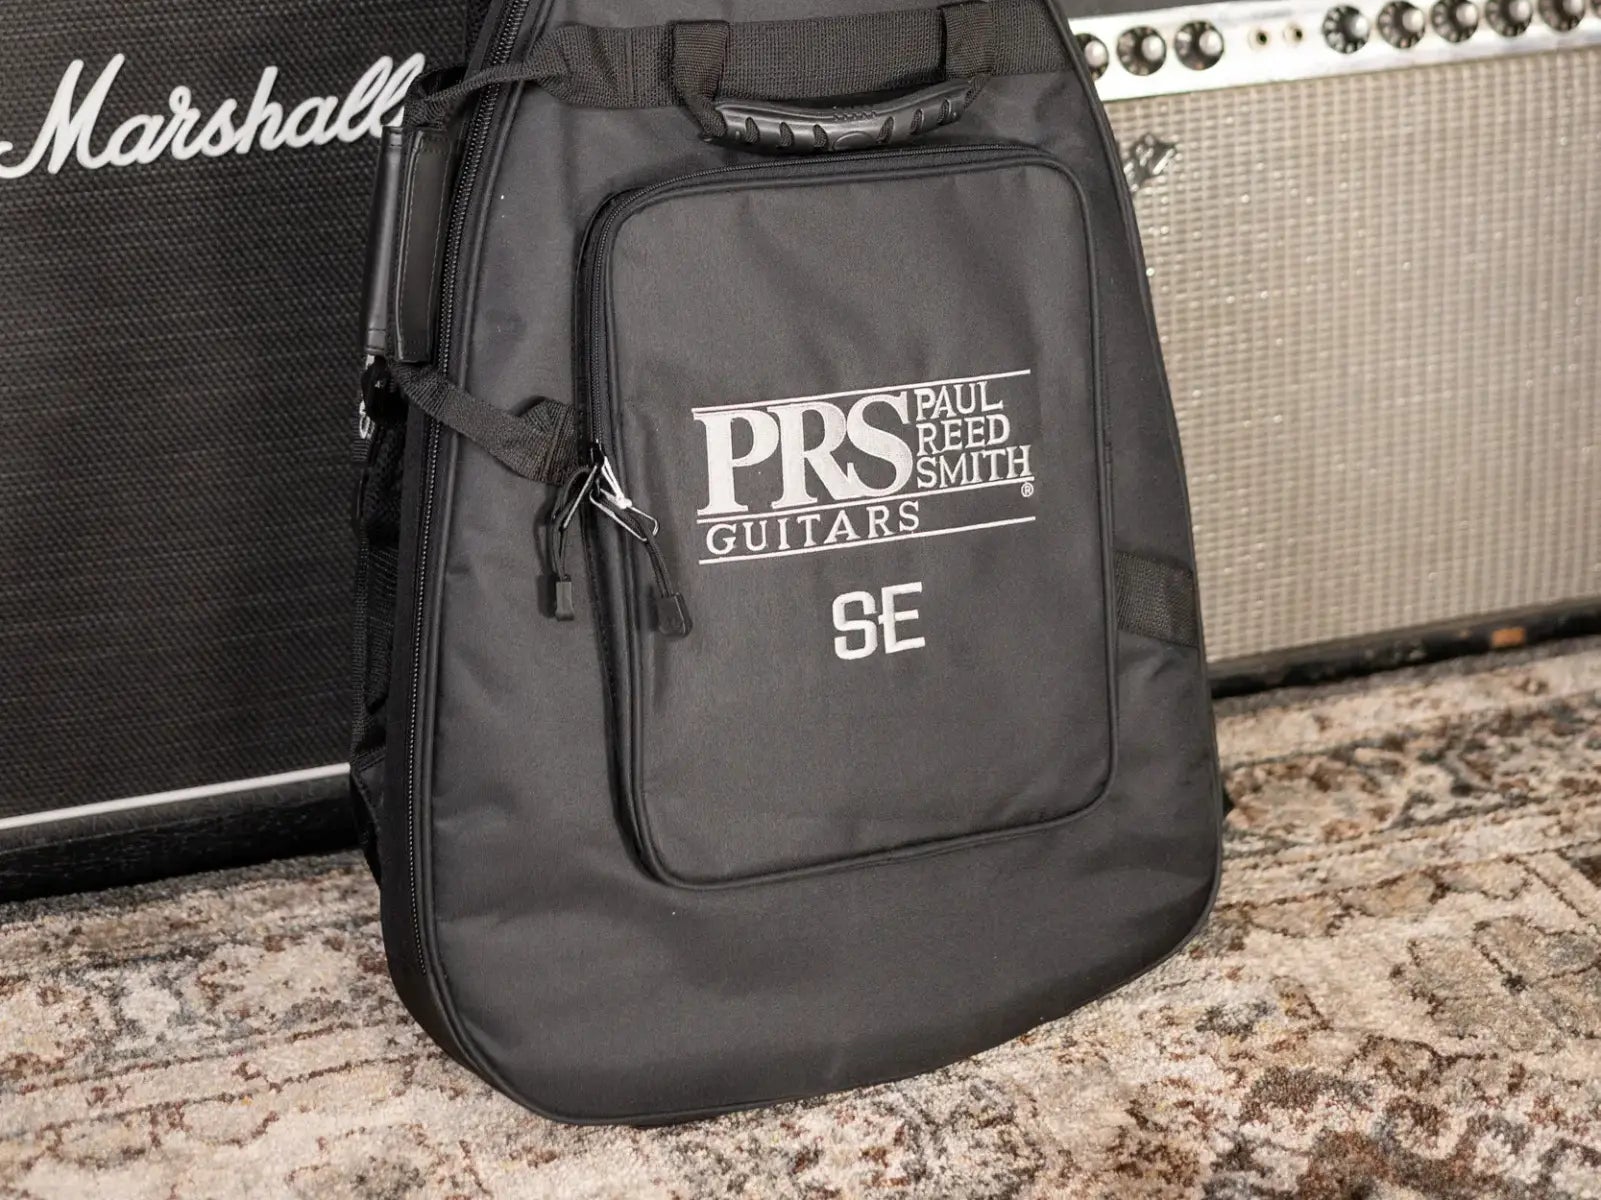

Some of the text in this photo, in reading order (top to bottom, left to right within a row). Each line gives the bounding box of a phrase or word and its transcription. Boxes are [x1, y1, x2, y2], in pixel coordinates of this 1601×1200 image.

[0, 53, 426, 179] Marshall
[915, 380, 1004, 421] PAUL
[693, 391, 913, 516] PRS
[915, 413, 1011, 457] REED
[916, 445, 1034, 489] SMITH
[705, 500, 920, 555] GUITARS
[832, 581, 926, 661] SE
